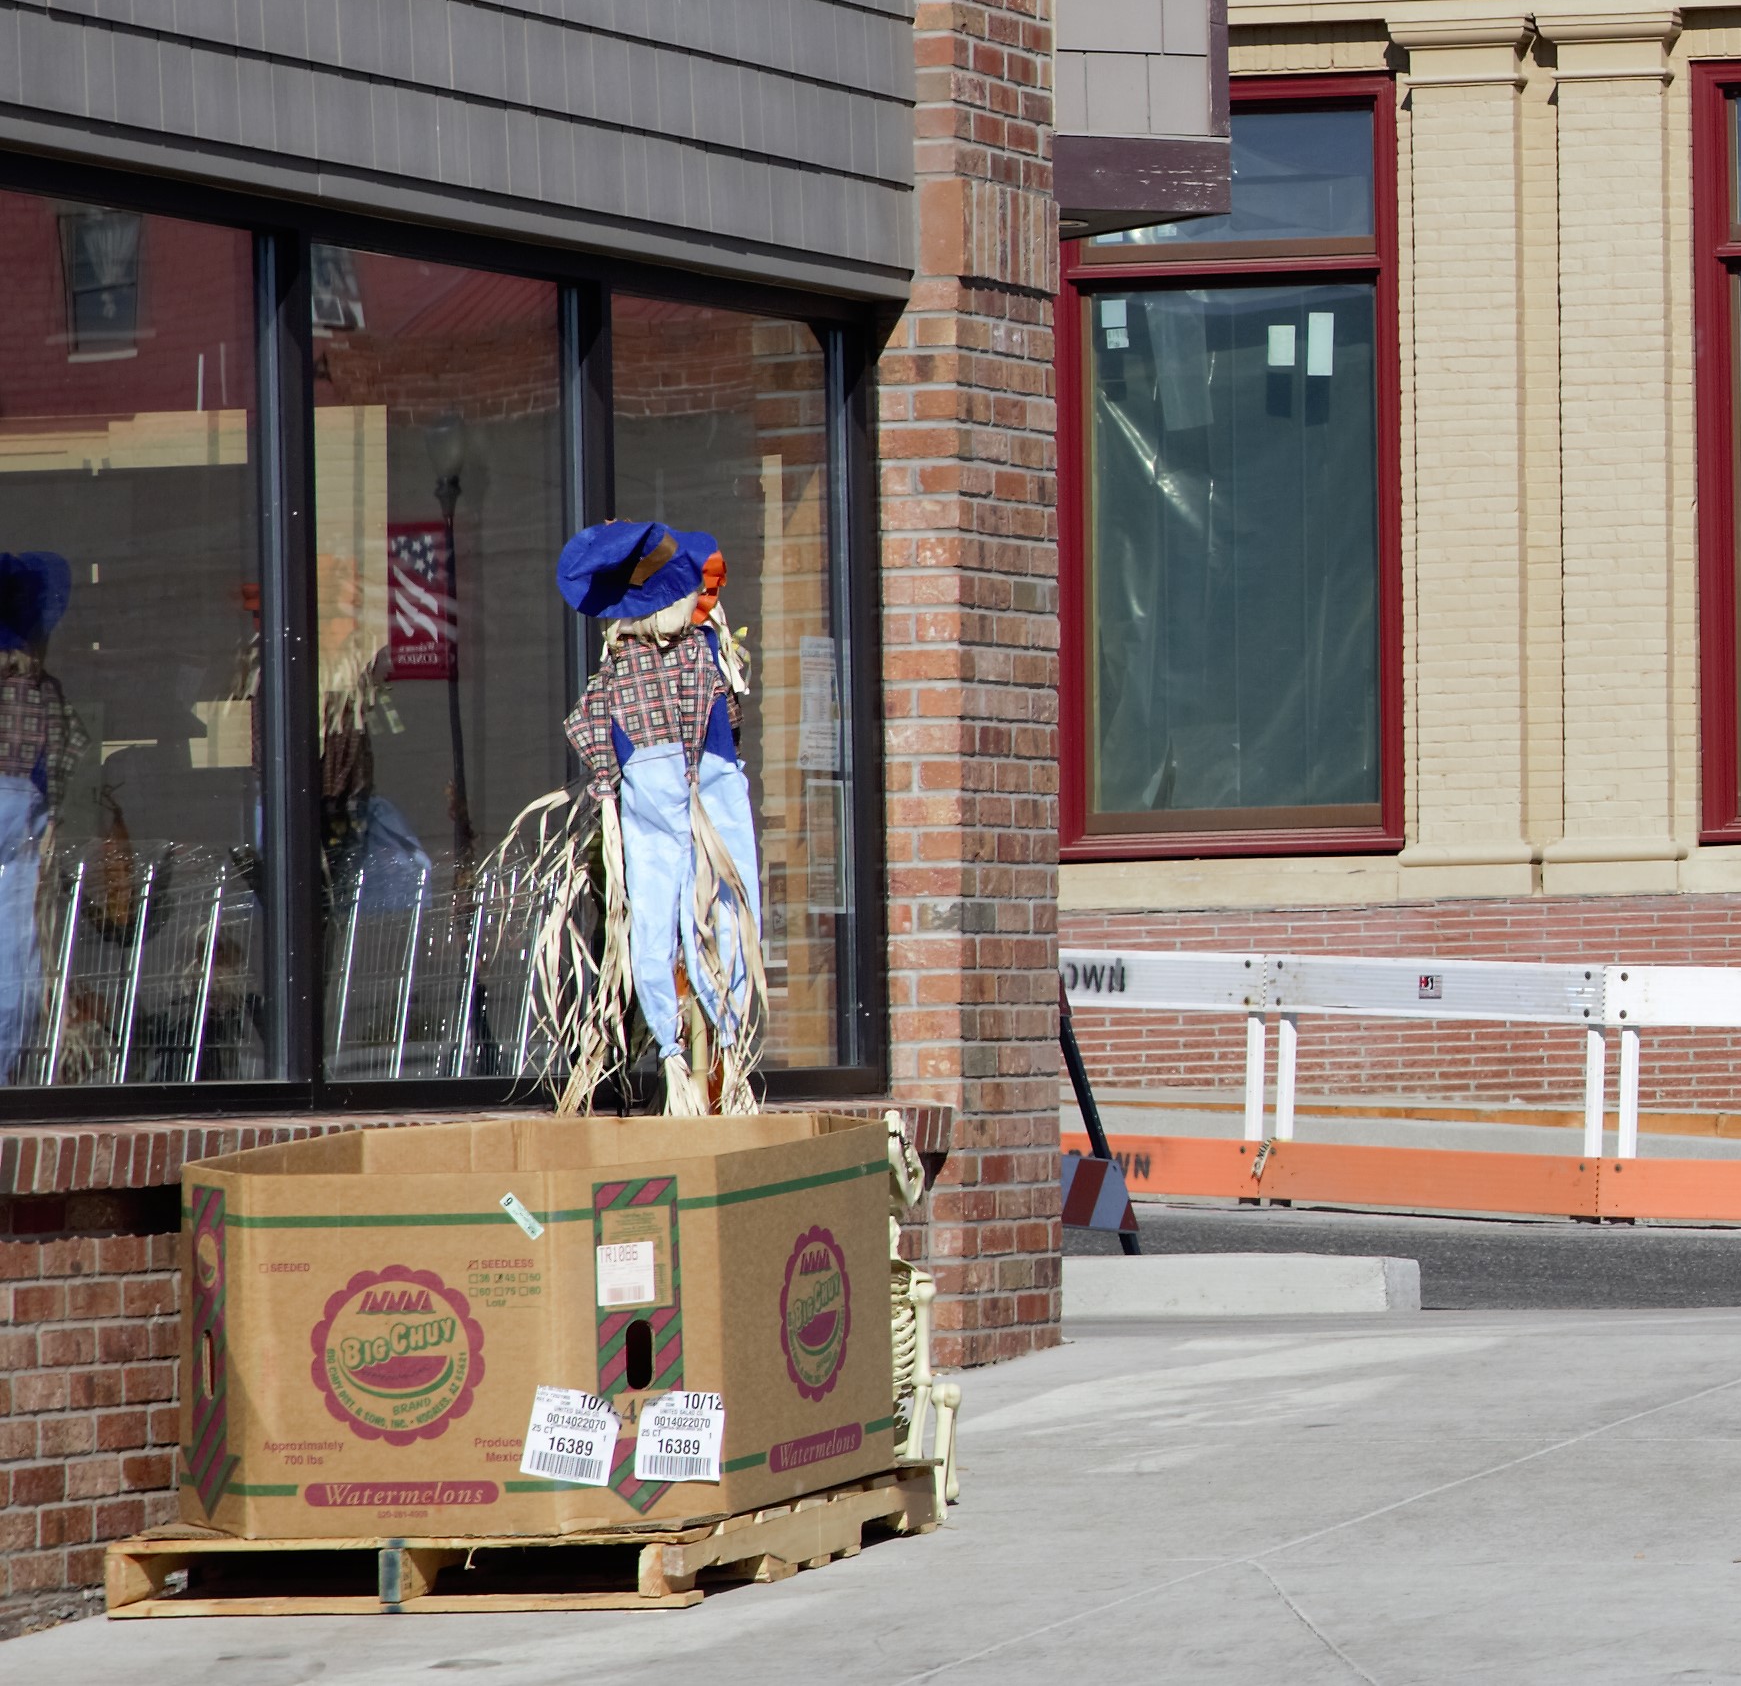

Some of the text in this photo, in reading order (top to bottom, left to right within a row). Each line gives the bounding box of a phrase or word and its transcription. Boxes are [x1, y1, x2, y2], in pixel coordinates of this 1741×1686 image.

[271, 1263, 310, 1272] SEEDED
[481, 1259, 534, 1268] SEEDLESS
[392, 1397, 431, 1416] BRAND
[547, 1413, 606, 1431] 0014022070
[654, 1416, 711, 1428] 0014022070
[263, 1440, 344, 1453] Approximately
[548, 1436, 594, 1457] 16389
[658, 1439, 700, 1454] 16389
[781, 1429, 856, 1467] Watermelons
[284, 1455, 304, 1465] 700
[325, 1482, 484, 1505] Watermelons
